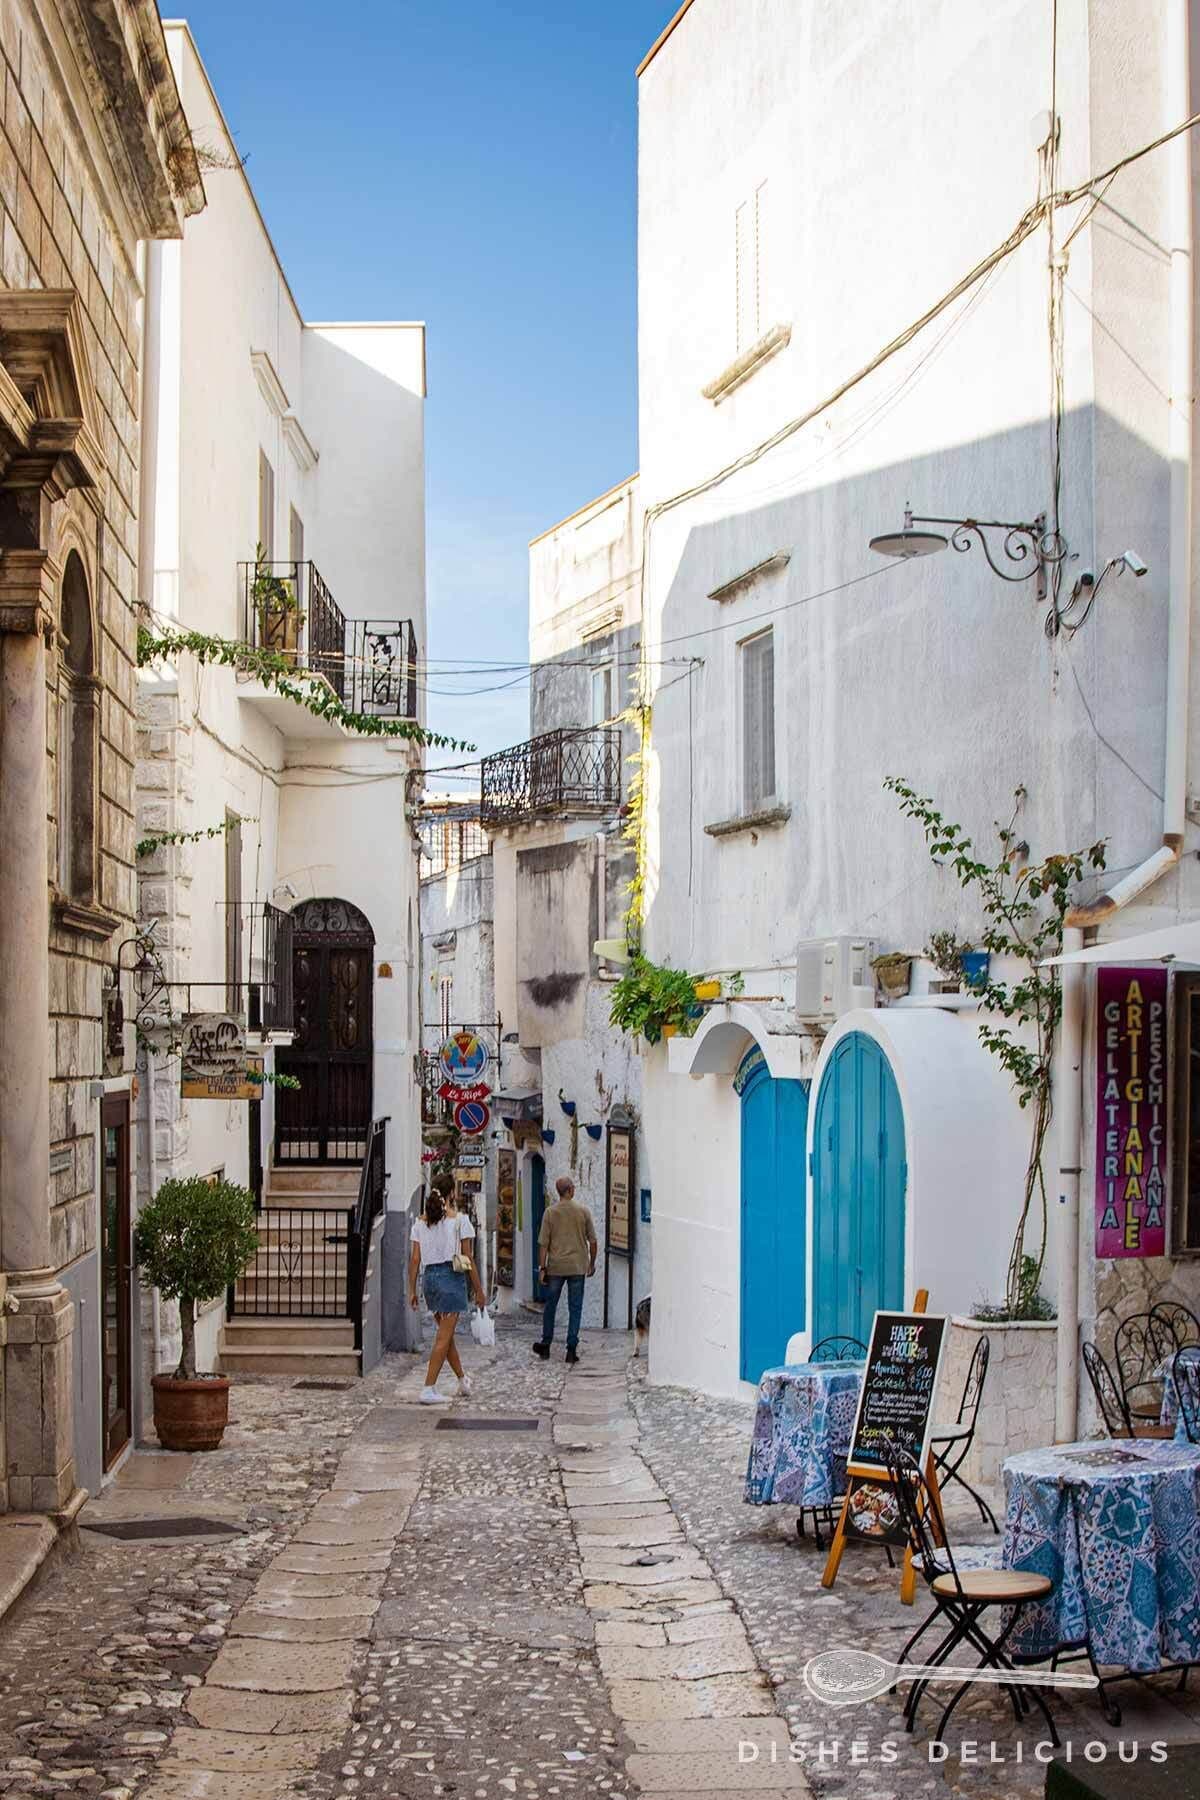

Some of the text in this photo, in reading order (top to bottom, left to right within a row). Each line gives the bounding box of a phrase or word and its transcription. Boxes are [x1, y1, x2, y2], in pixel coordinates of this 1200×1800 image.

[207, 1084, 237, 1094] ETNICO
[1100, 1001, 1121, 1229] GELATERIA
[1123, 979, 1144, 1250] ARTIGIANALE
[1145, 1001, 1163, 1228] PESCHICIANA
[890, 1325, 924, 1342] HAPPY
[892, 1341, 919, 1358] HOUR
